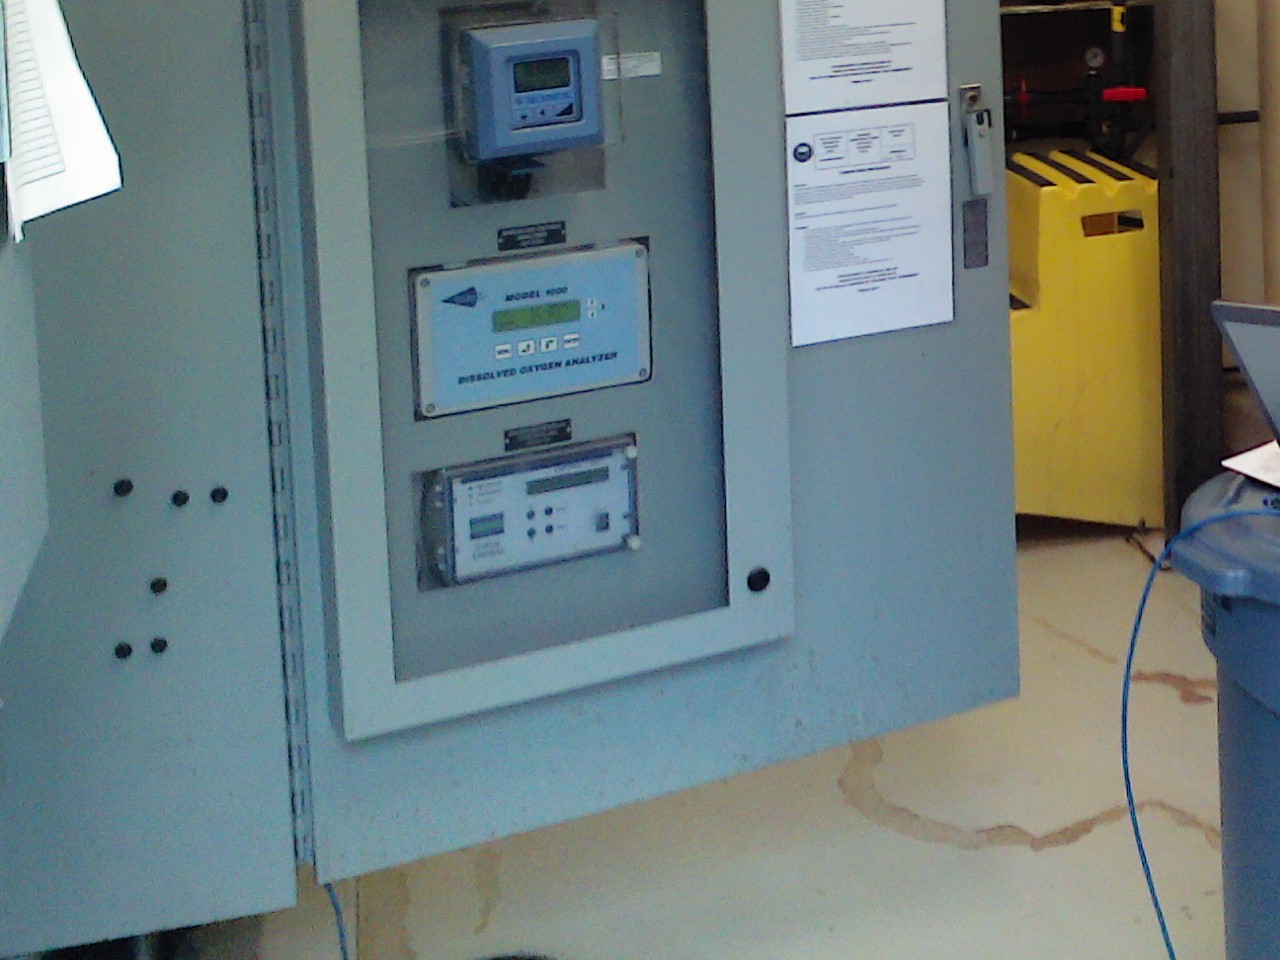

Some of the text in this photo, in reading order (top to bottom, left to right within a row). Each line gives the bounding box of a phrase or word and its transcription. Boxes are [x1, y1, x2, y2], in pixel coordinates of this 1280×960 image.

[505, 289, 540, 302] MODEL
[458, 351, 618, 385] DISSOLVED OXYGEN ANALYZER
